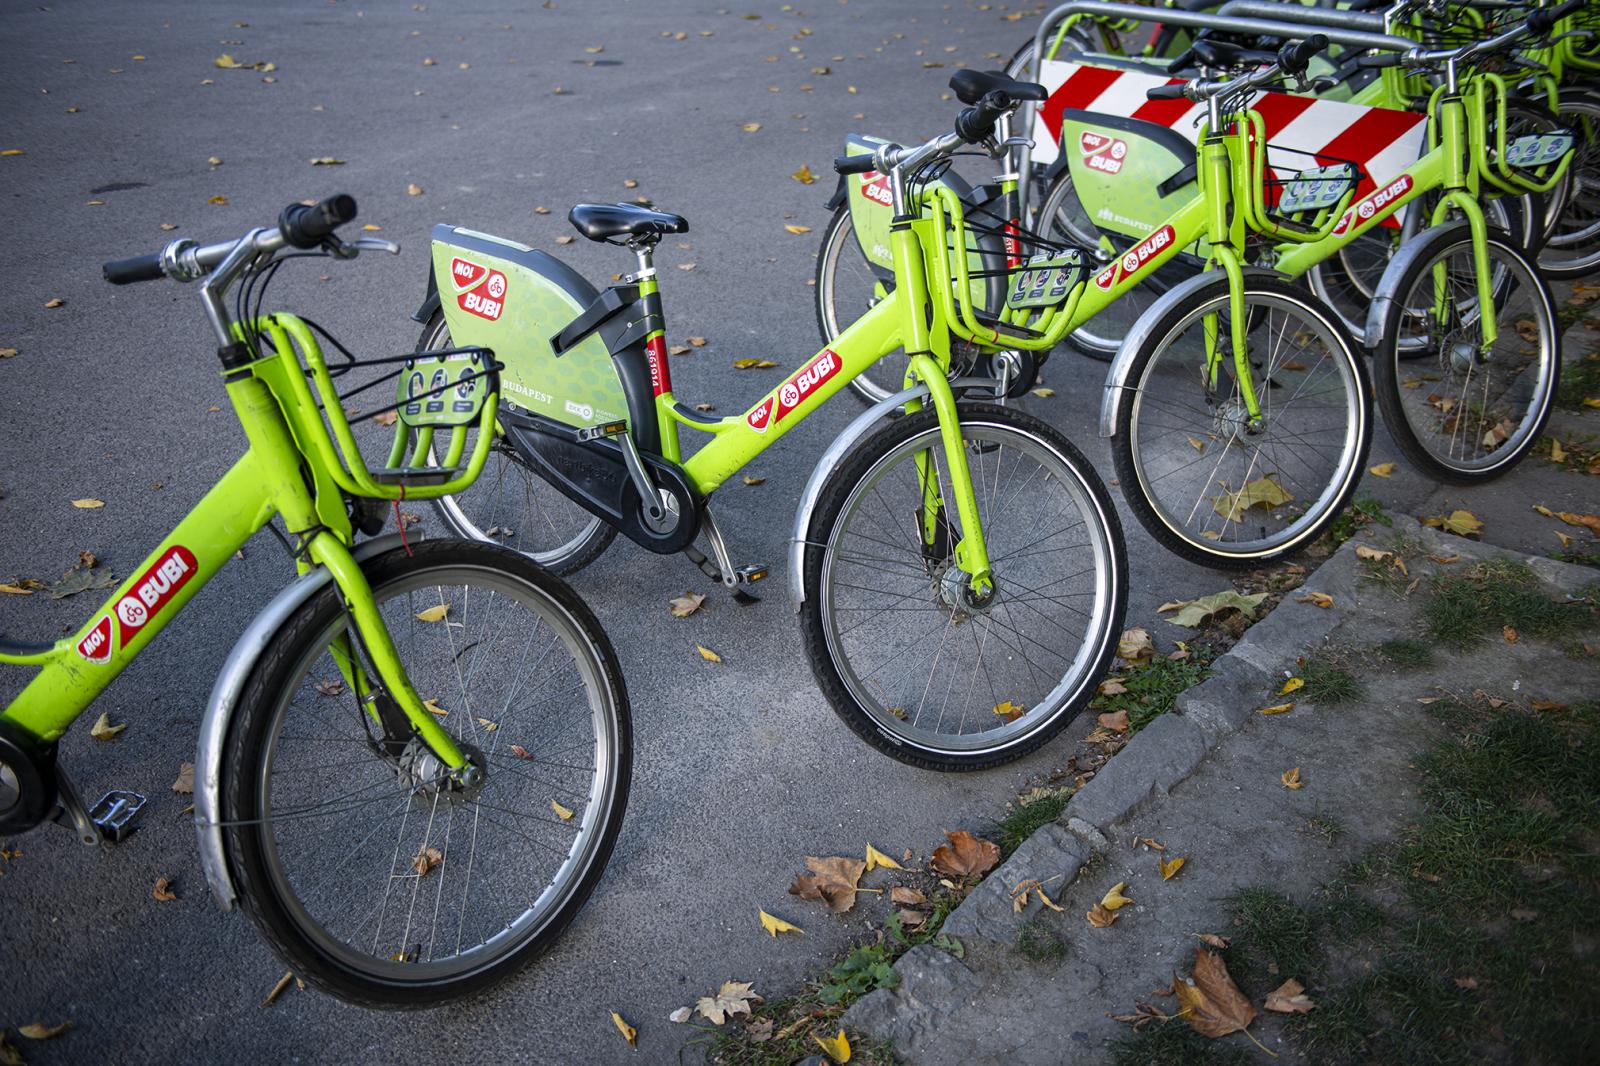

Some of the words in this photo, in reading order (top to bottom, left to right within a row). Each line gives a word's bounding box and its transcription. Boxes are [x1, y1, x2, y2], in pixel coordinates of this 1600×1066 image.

[1083, 134, 1101, 146] MOL
[1089, 155, 1122, 173] BUBI
[1373, 177, 1408, 208] BUBI
[1137, 230, 1169, 260] BUBI
[454, 262, 475, 279] MOL
[1098, 271, 1112, 284] MOL
[464, 294, 502, 320] BUBI
[796, 353, 835, 394] BUBI
[503, 379, 554, 404] BUDAPEST
[751, 406, 768, 425] MOL
[138, 552, 189, 608] BUBI
[83, 629, 105, 656] MOL
